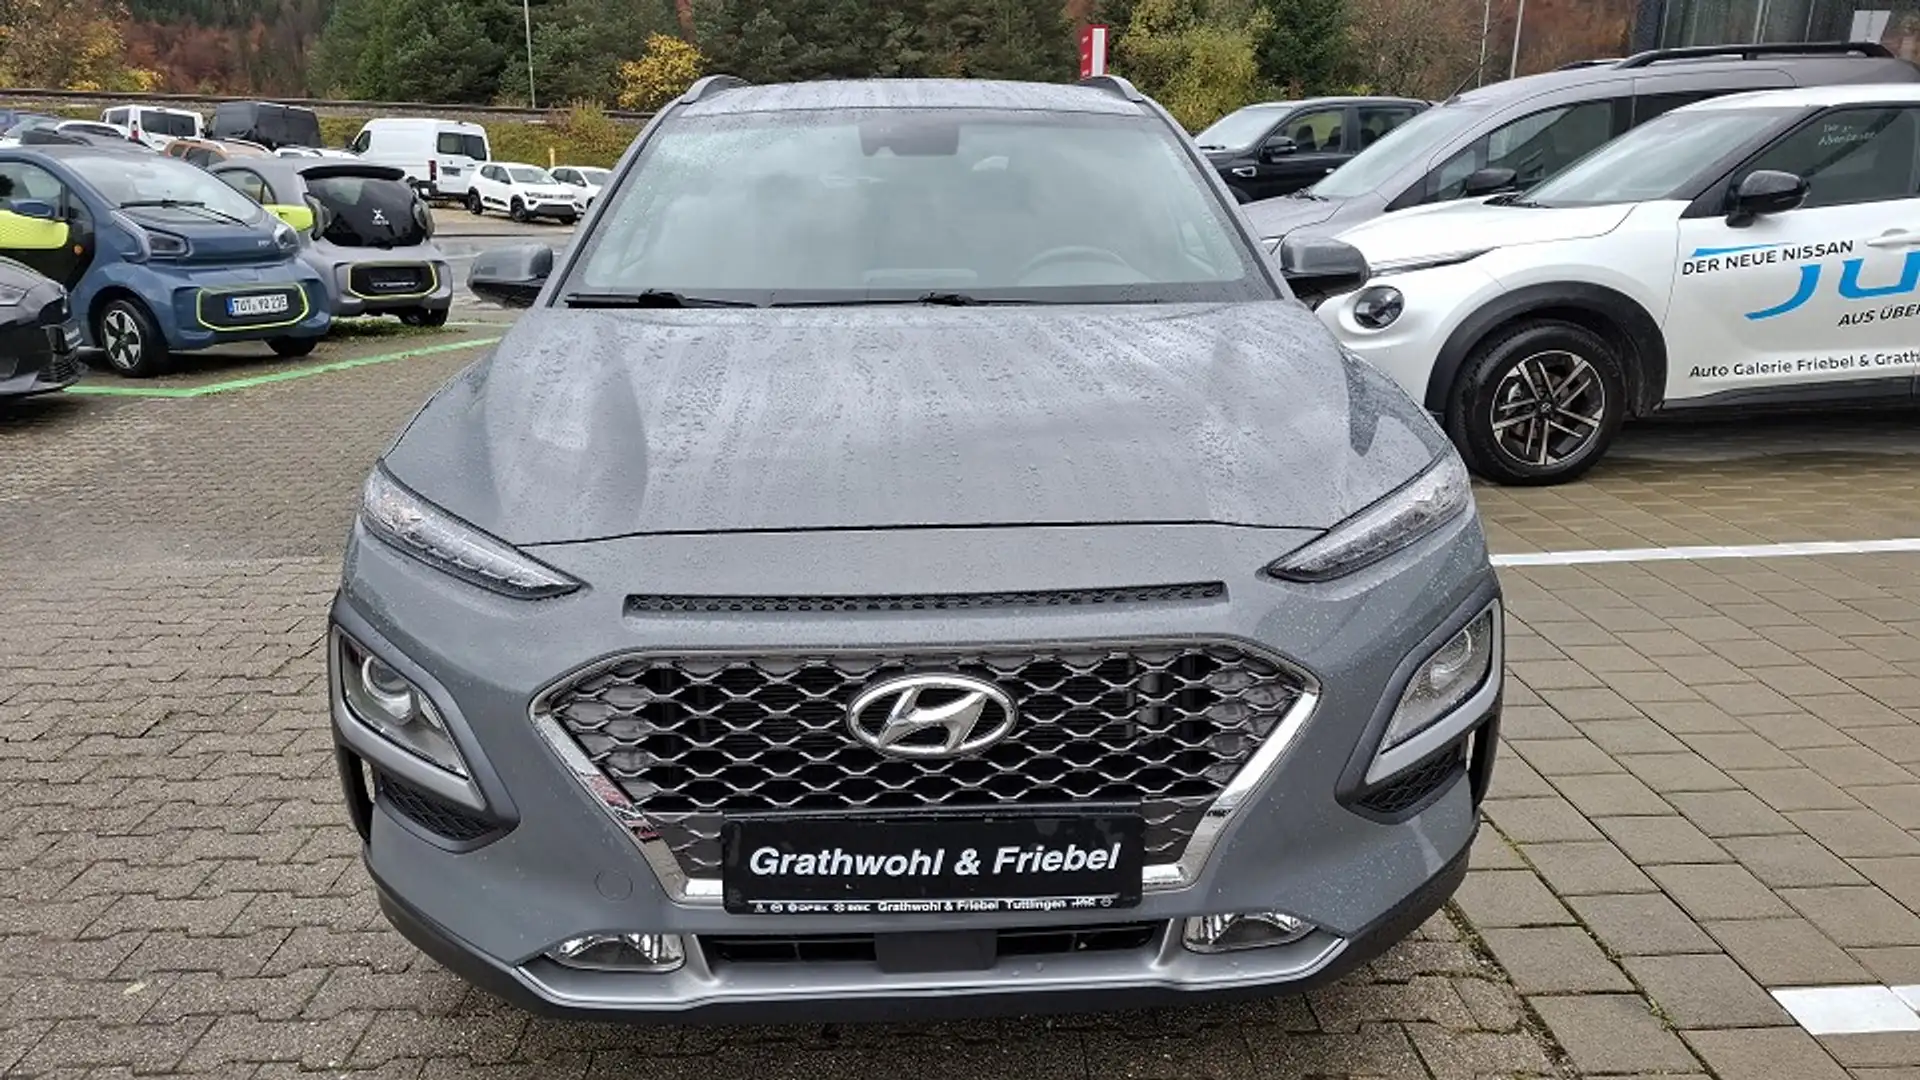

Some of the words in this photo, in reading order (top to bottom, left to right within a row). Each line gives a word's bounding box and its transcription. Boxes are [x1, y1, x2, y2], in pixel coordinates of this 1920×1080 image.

[1682, 256, 1719, 276] DER
[1725, 249, 1777, 269] NEUE
[1782, 240, 1854, 260] NISSAN
[1838, 308, 1876, 327] AUS
[1689, 365, 1729, 378] Auto
[1734, 359, 1793, 376] Galerie
[1797, 354, 1854, 371] Friebel
[1859, 354, 1871, 368] &
[749, 846, 945, 876] Grathwohl
[954, 848, 980, 876] &
[992, 842, 1122, 874] Friebel
[878, 901, 941, 912] Grathwohl
[944, 901, 953, 911] &
[957, 900, 1000, 911] Friebel
[1005, 898, 1067, 911] Tuttlingen
